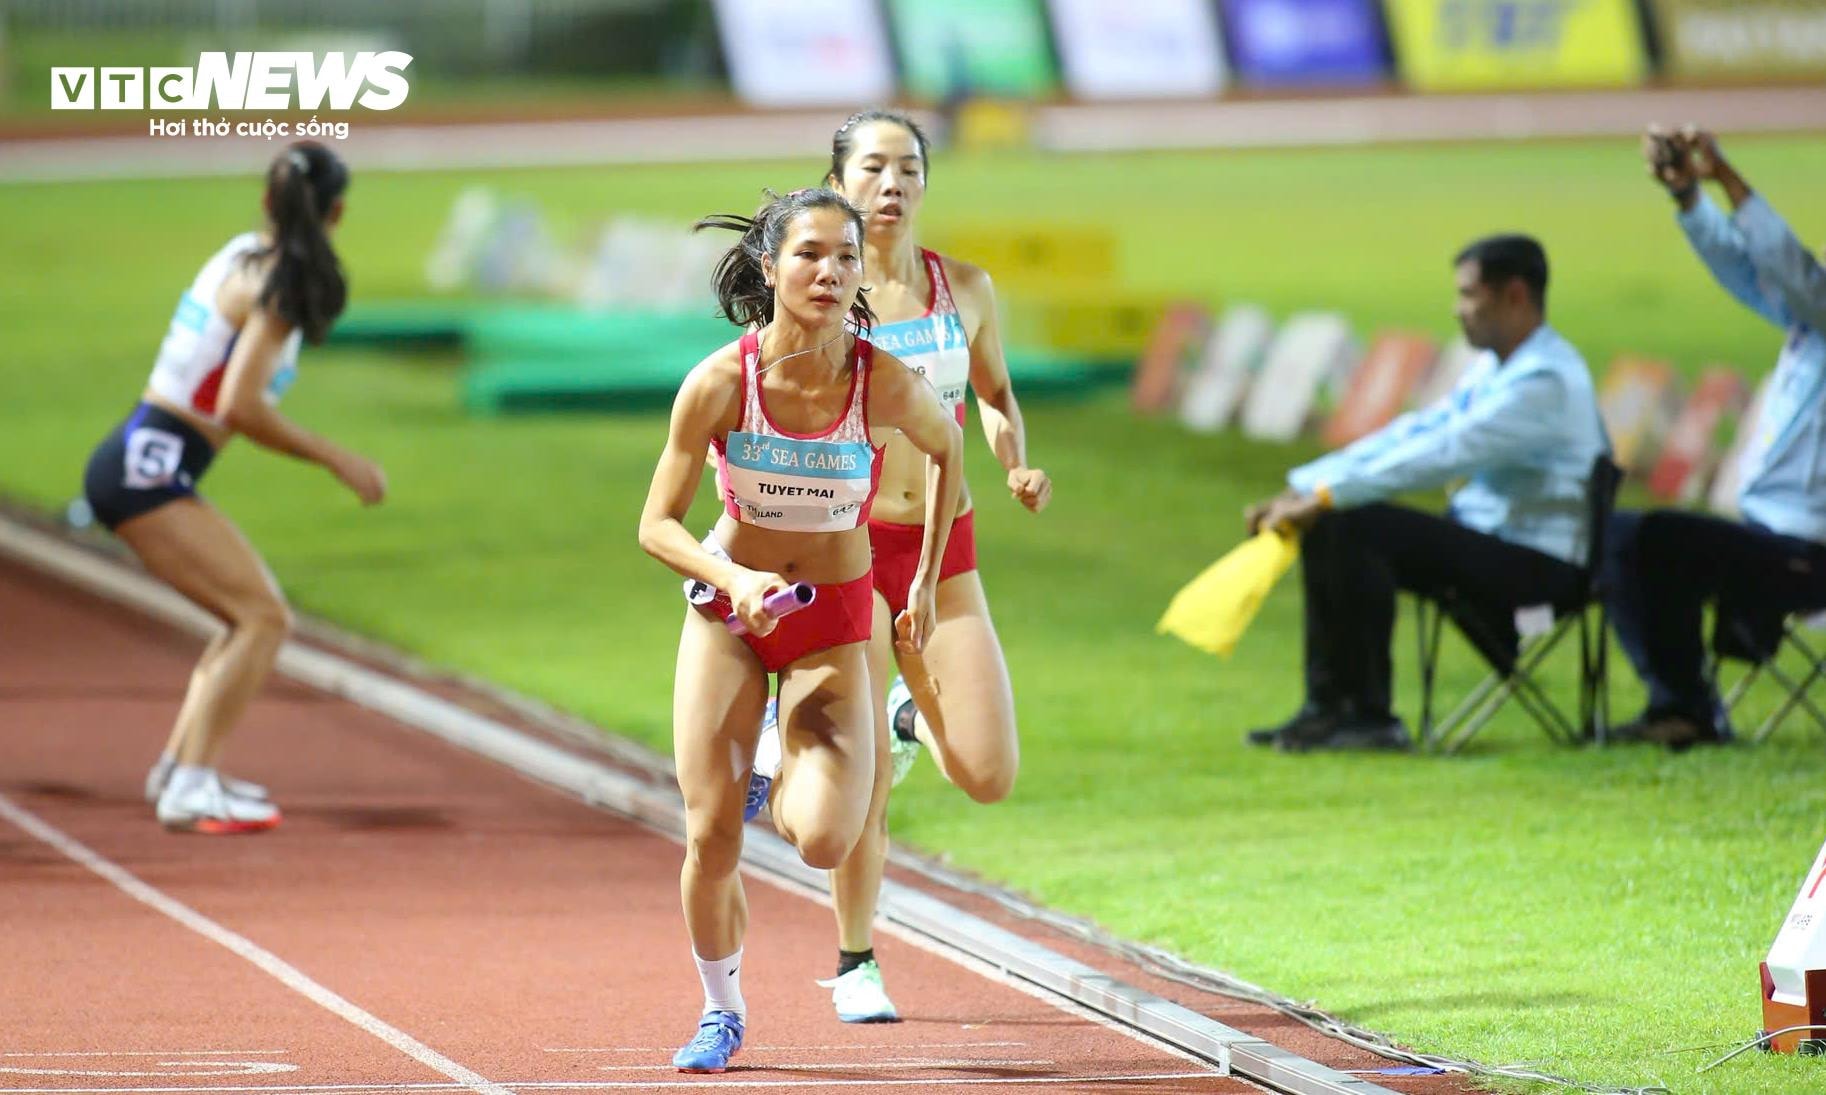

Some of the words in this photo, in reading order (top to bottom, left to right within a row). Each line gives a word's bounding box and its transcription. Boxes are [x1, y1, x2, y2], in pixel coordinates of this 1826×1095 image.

[138, 440, 169, 479] 5
[742, 442, 770, 461] 33rd
[771, 448, 799, 467] SEA
[805, 452, 857, 471] GAMES
[758, 483, 804, 496] TUYET
[807, 488, 834, 499] MAI
